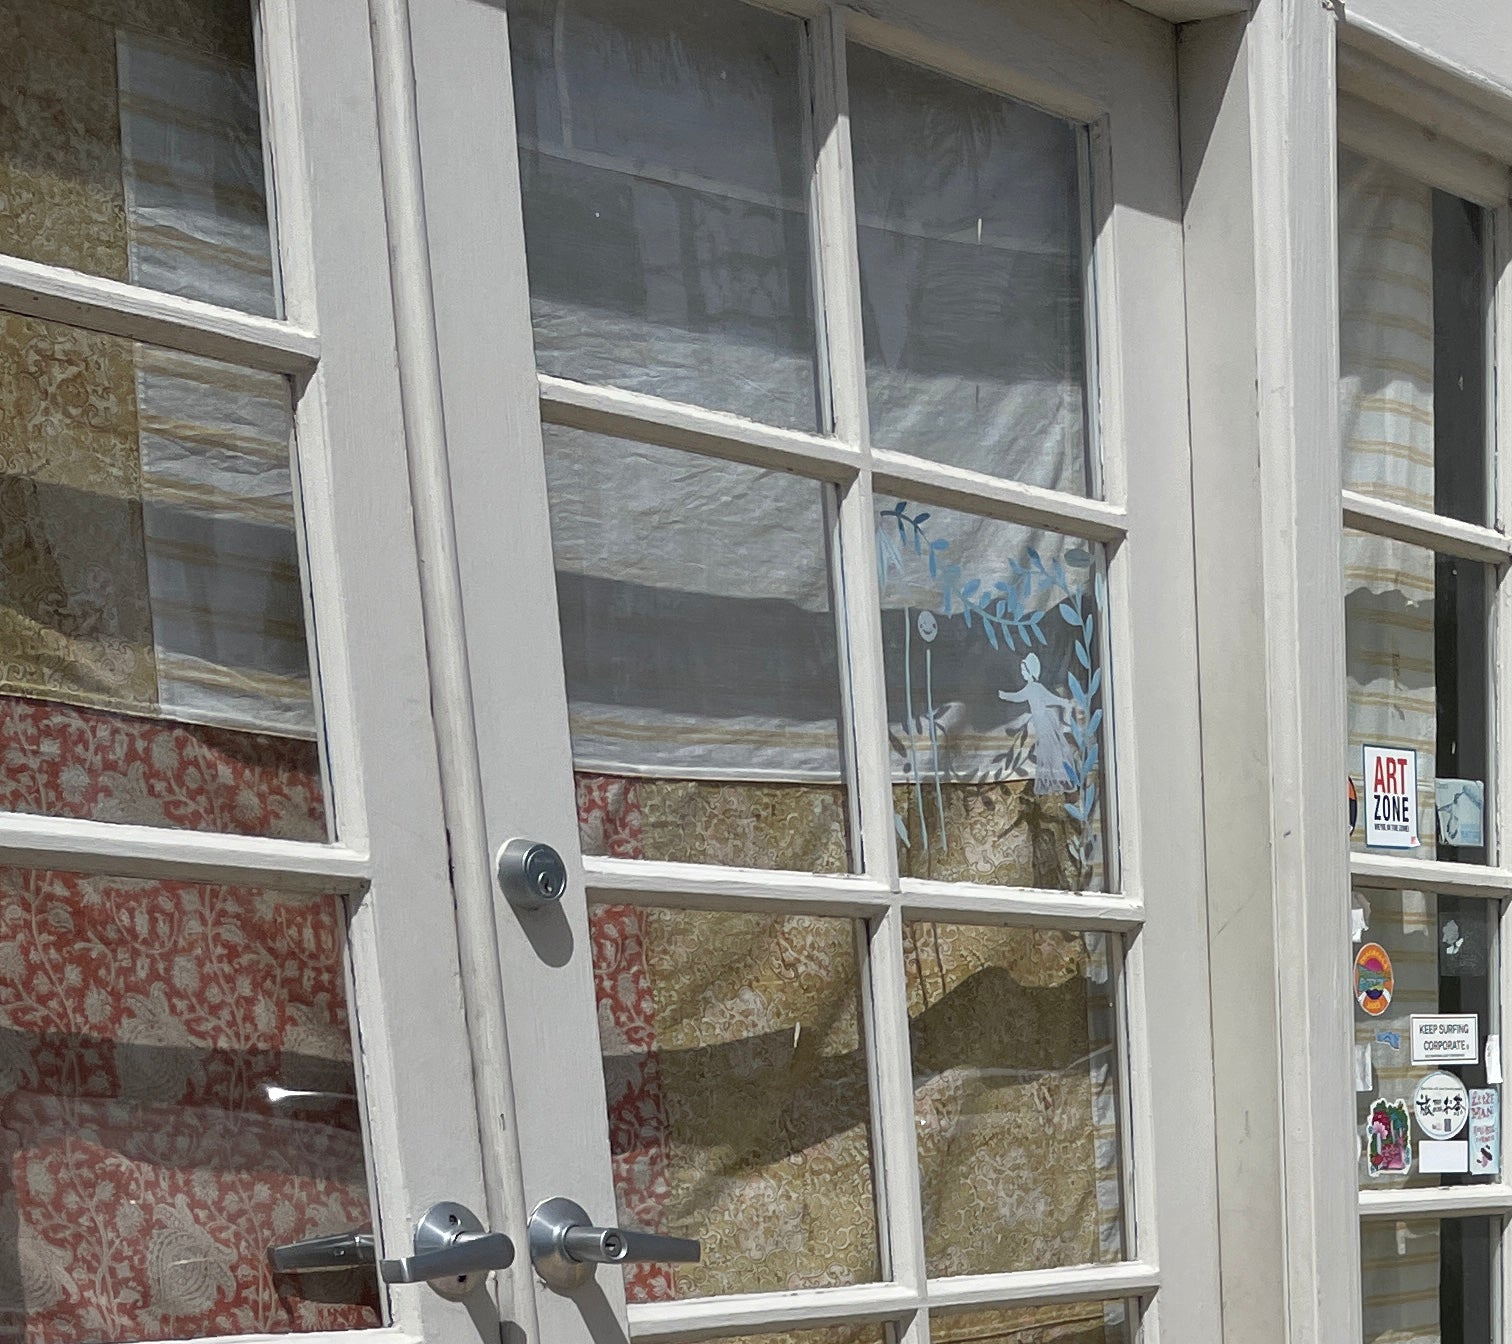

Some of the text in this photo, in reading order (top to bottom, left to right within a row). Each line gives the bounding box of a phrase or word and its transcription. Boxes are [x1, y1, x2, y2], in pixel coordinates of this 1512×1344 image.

[1374, 756, 1408, 795] ART
[1374, 795, 1409, 822] ZONE
[1419, 1024, 1469, 1034] KEEP SURFING
